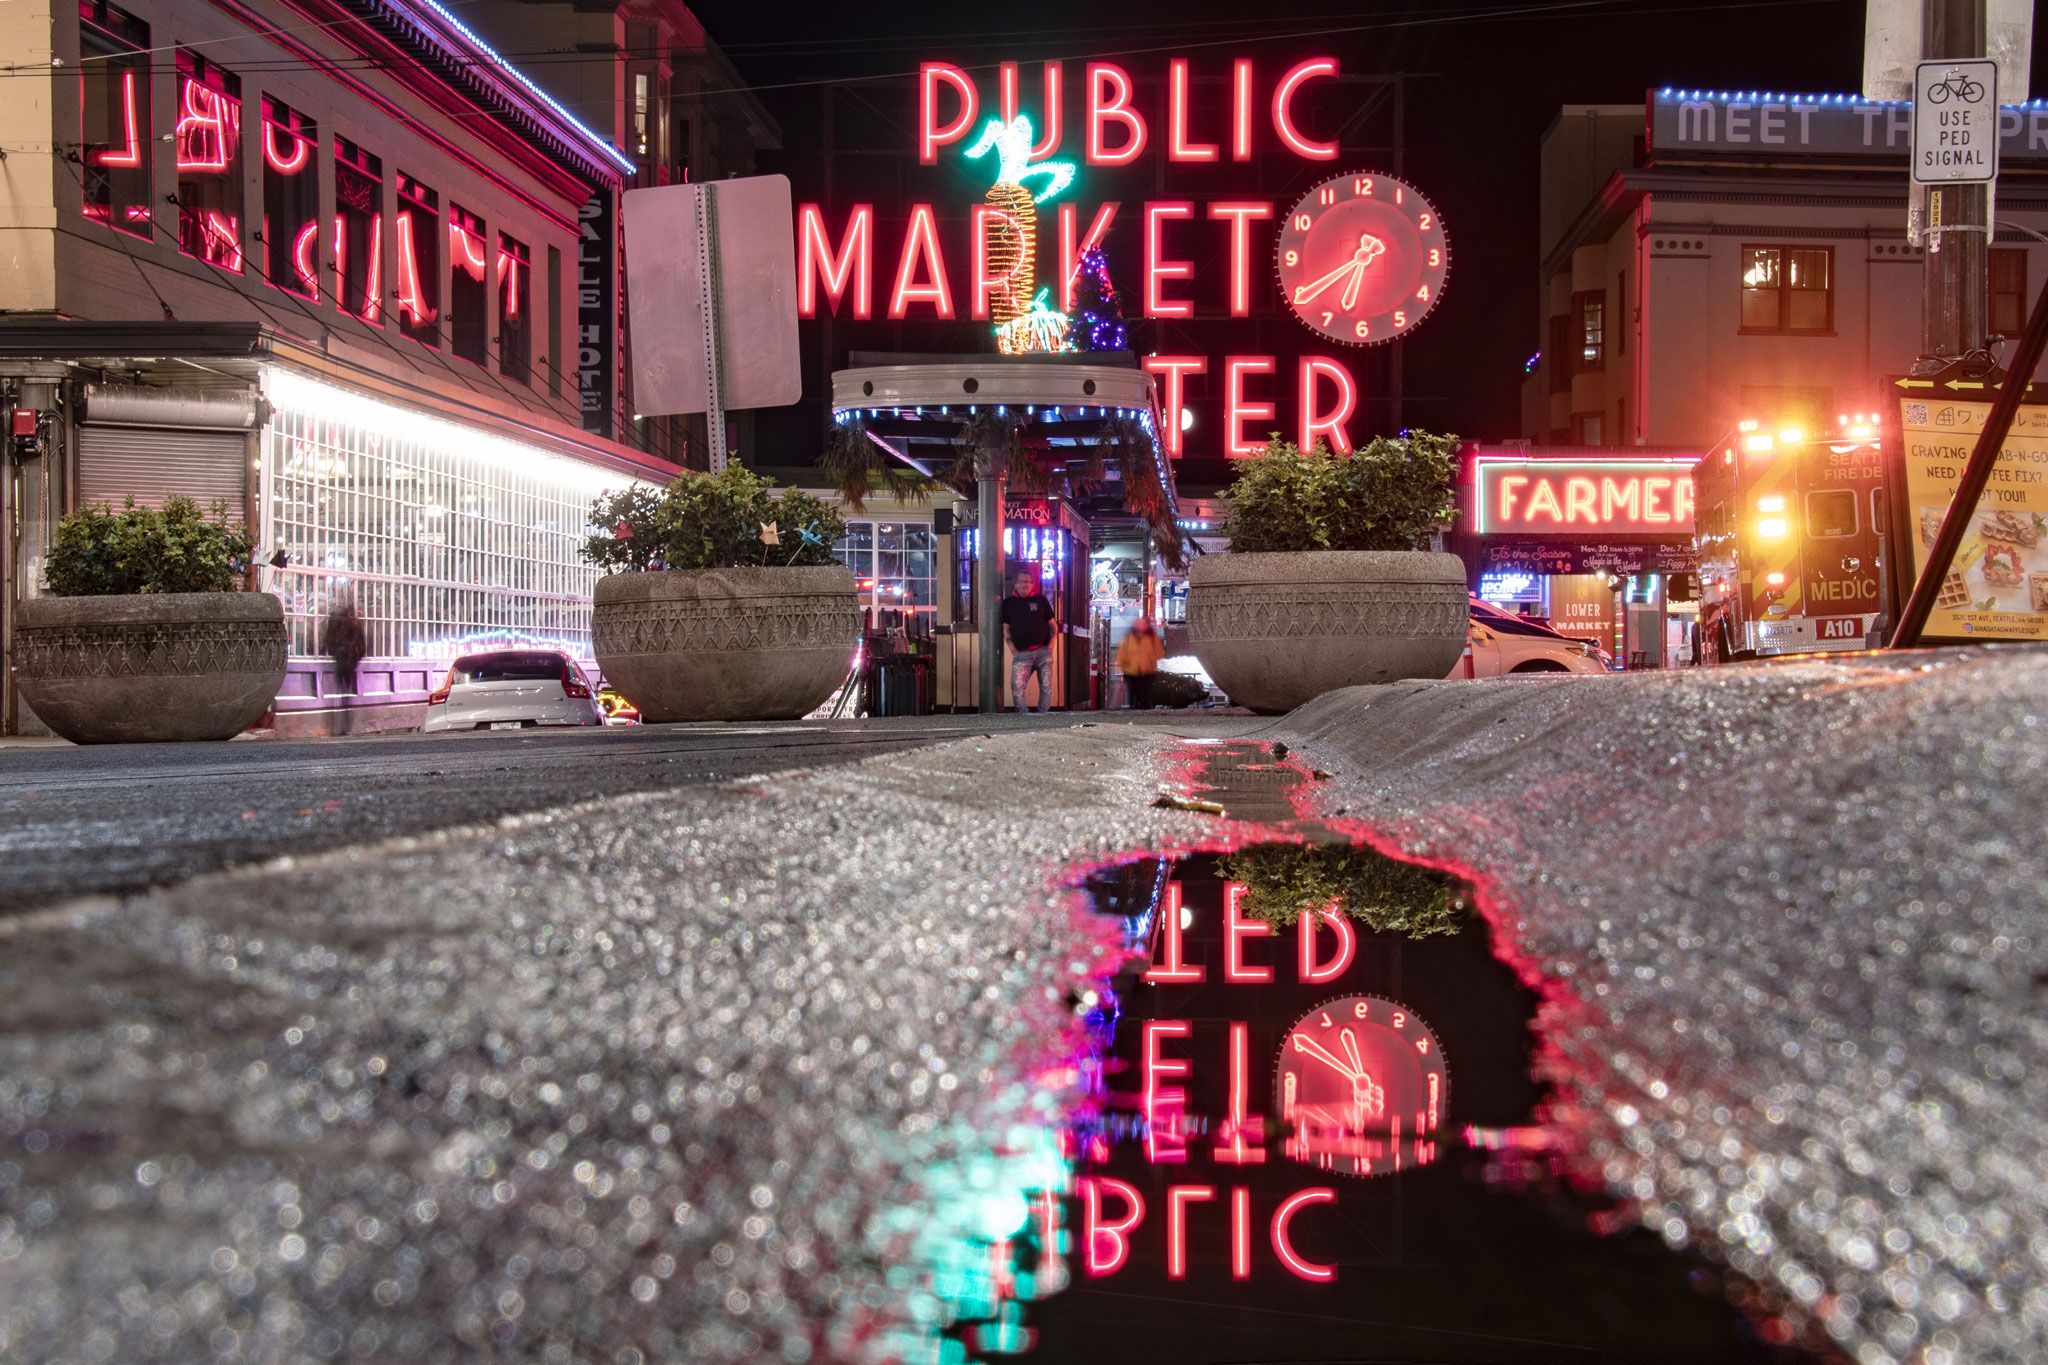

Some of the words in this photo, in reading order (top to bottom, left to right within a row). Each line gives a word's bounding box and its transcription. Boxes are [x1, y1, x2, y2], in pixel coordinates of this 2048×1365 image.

[919, 59, 1341, 167] PUBLIC
[1939, 110, 1971, 127] USE
[1678, 102, 1820, 145] MEET
[1853, 105, 1913, 147] TH
[2000, 109, 2048, 150] PR
[1939, 130, 1971, 146] PED
[1924, 149, 1985, 166] SIGNAL
[1355, 178, 1373, 195] 12
[1321, 188, 1334, 205] 11
[1396, 188, 1402, 204] 1
[1294, 214, 1311, 230] 10
[1419, 213, 1431, 230] 2
[578, 198, 603, 309] SALLE
[795, 202, 1276, 322] MARKET
[1285, 250, 1298, 267] 9
[1428, 249, 1440, 267] 3
[1416, 284, 1430, 301] 4
[1321, 311, 1334, 327] 7
[1394, 311, 1406, 327] 5
[1355, 320, 1369, 338] 6
[578, 324, 602, 437] HOTEL
[1140, 352, 1357, 460] TER
[1957, 409, 2027, 428] ワッル
[1829, 452, 1881, 466] SEATT
[1911, 444, 1967, 459] CRAVING
[2000, 449, 2048, 463] AB-N-GO
[1824, 467, 1858, 480] FIRE
[1863, 466, 1882, 478] DE
[1926, 466, 1956, 479] NEED
[1993, 470, 2012, 482] FEE
[2015, 470, 2042, 483] FIX?
[1999, 490, 2027, 502] YOU!!
[962, 508, 1050, 520] INFMATION
[1532, 546, 1572, 560] Season
[1581, 545, 1597, 553] Nov.
[1666, 558, 1686, 569] Figgy
[1811, 579, 1877, 600] MEDIC
[1565, 603, 1601, 617] LOWER
[1556, 621, 1611, 630] MARKET
[1824, 620, 1855, 637] A10
